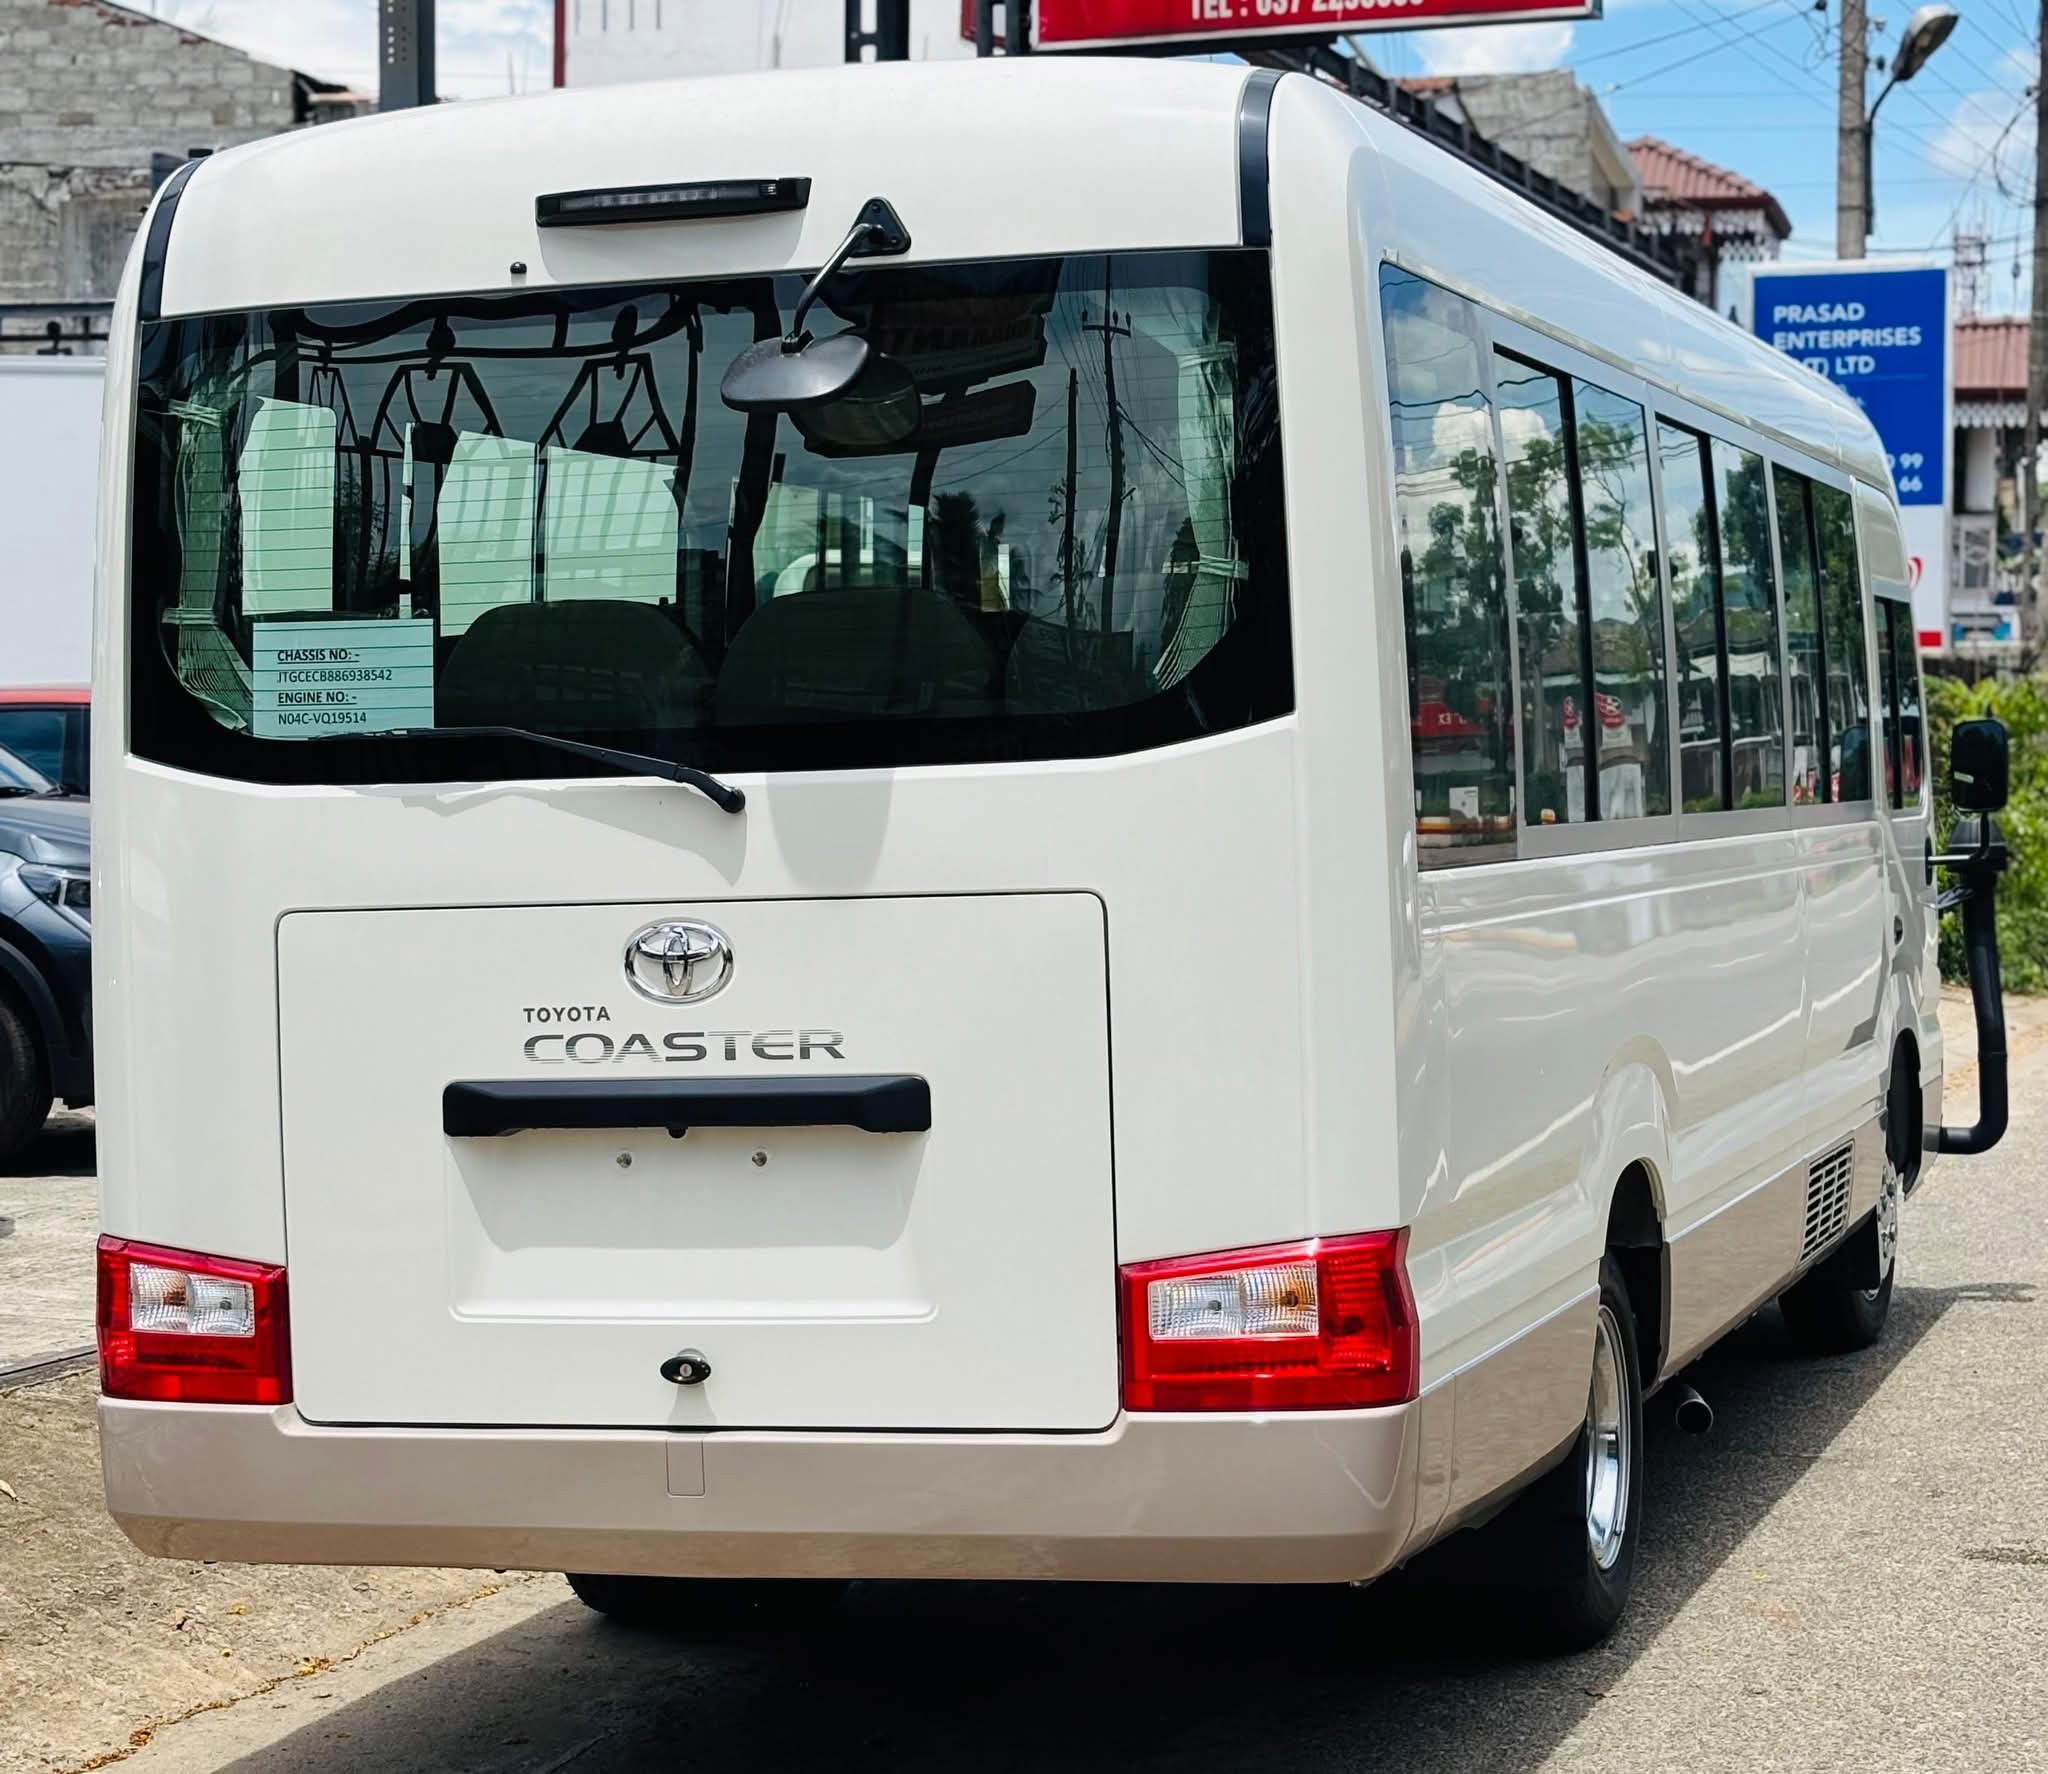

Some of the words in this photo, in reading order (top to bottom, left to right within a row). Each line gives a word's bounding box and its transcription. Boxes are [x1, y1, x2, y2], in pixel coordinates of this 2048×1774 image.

[1192, 0, 1233, 19] TEL
[1773, 302, 1865, 324] PRASAD
[1773, 326, 1922, 350] ENTERPRISES
[1835, 355, 1876, 375] LTD
[1899, 453, 1924, 470] 99
[1899, 475, 1923, 492] 66
[277, 649, 326, 661] CHASSIS
[329, 649, 352, 661] NO:
[277, 669, 393, 683] JTGCECB886938542
[278, 692, 322, 703] ENGINE
[326, 691, 349, 702] NO:
[523, 1006, 611, 1023] TOYOTA
[523, 1029, 846, 1064] COASTER
